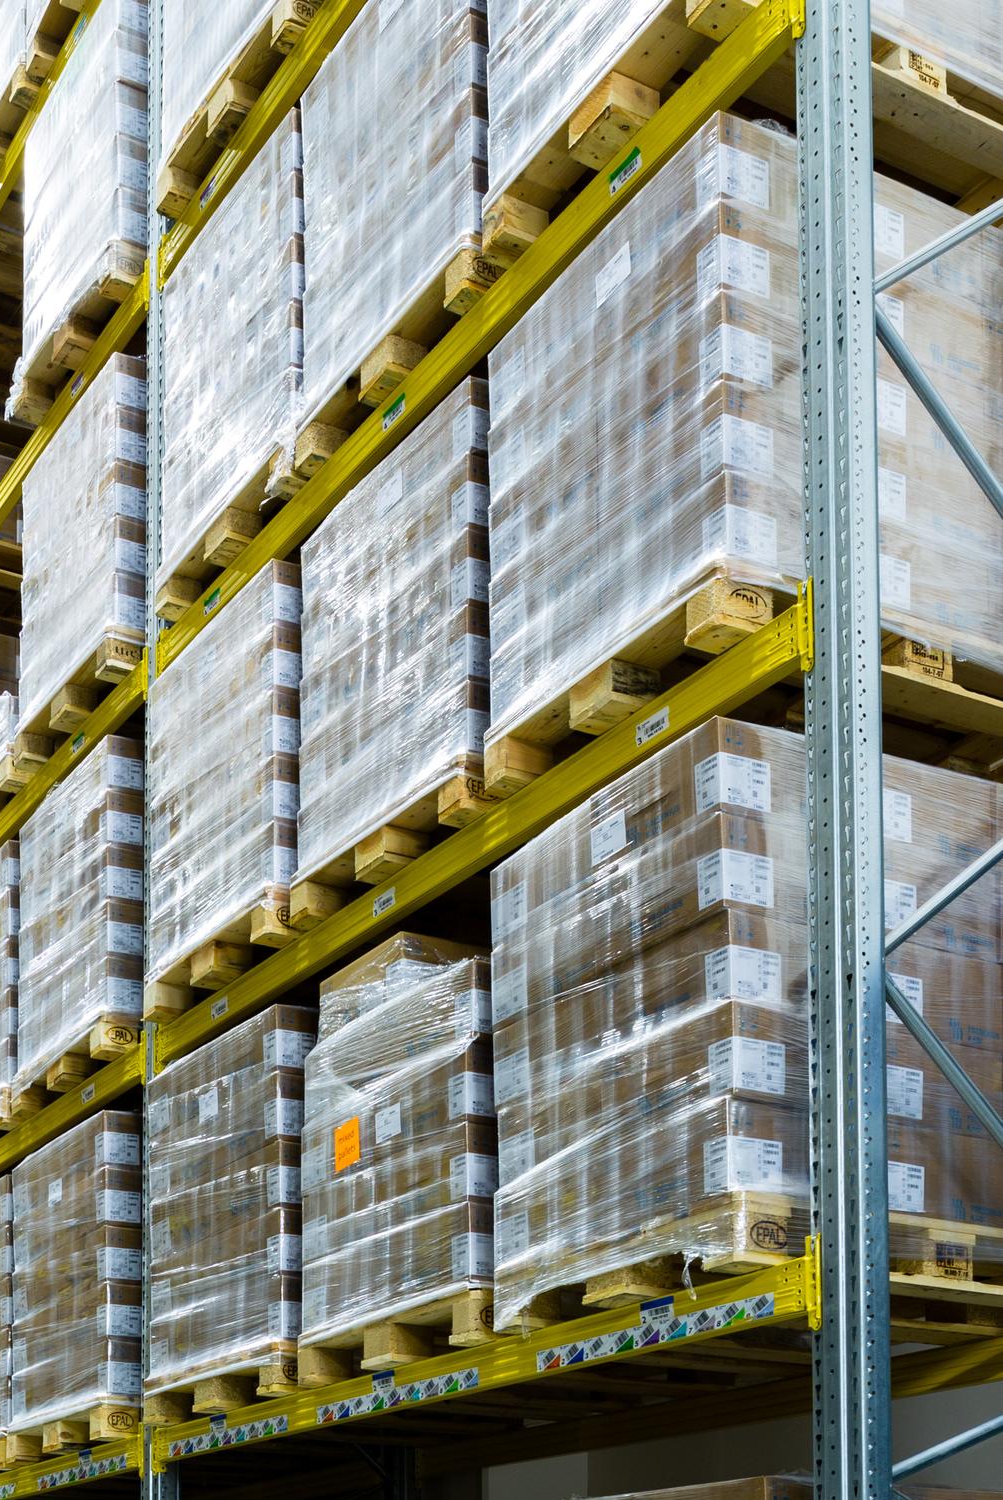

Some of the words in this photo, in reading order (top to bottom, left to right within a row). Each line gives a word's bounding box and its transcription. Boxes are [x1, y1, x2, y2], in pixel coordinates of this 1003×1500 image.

[755, 1226, 783, 1246] EPAL
[641, 1316, 647, 1324] 2
[110, 1415, 131, 1427] EPAL
